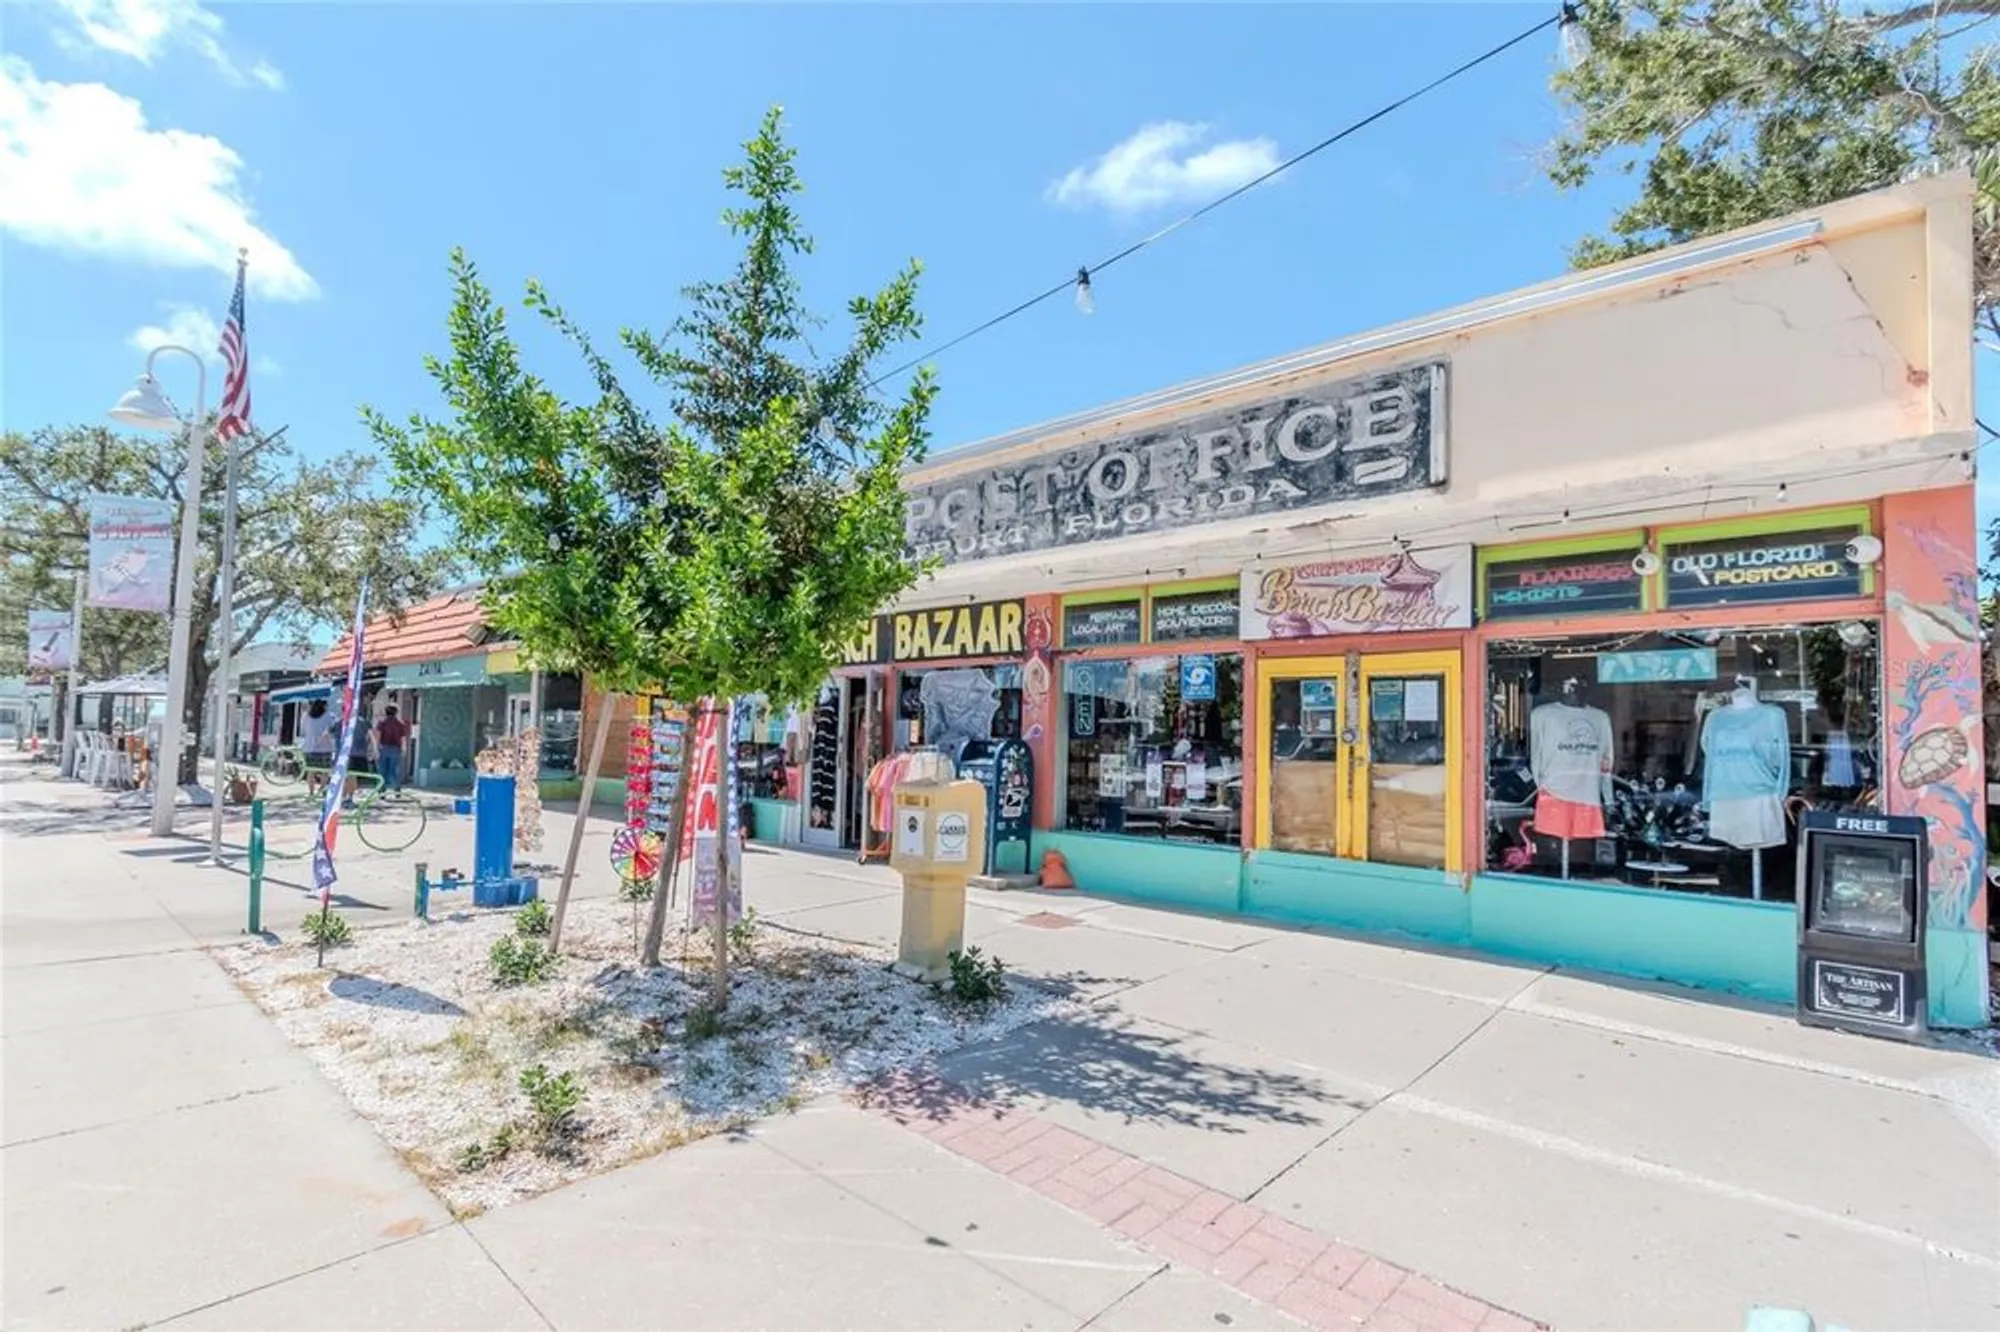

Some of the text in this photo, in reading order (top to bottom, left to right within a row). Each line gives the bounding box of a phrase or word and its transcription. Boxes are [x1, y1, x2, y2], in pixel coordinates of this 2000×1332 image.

[1065, 478, 1307, 535] FLORIDA
[895, 603, 1023, 660] BAZAAR
[1836, 817, 1889, 833] FREE
